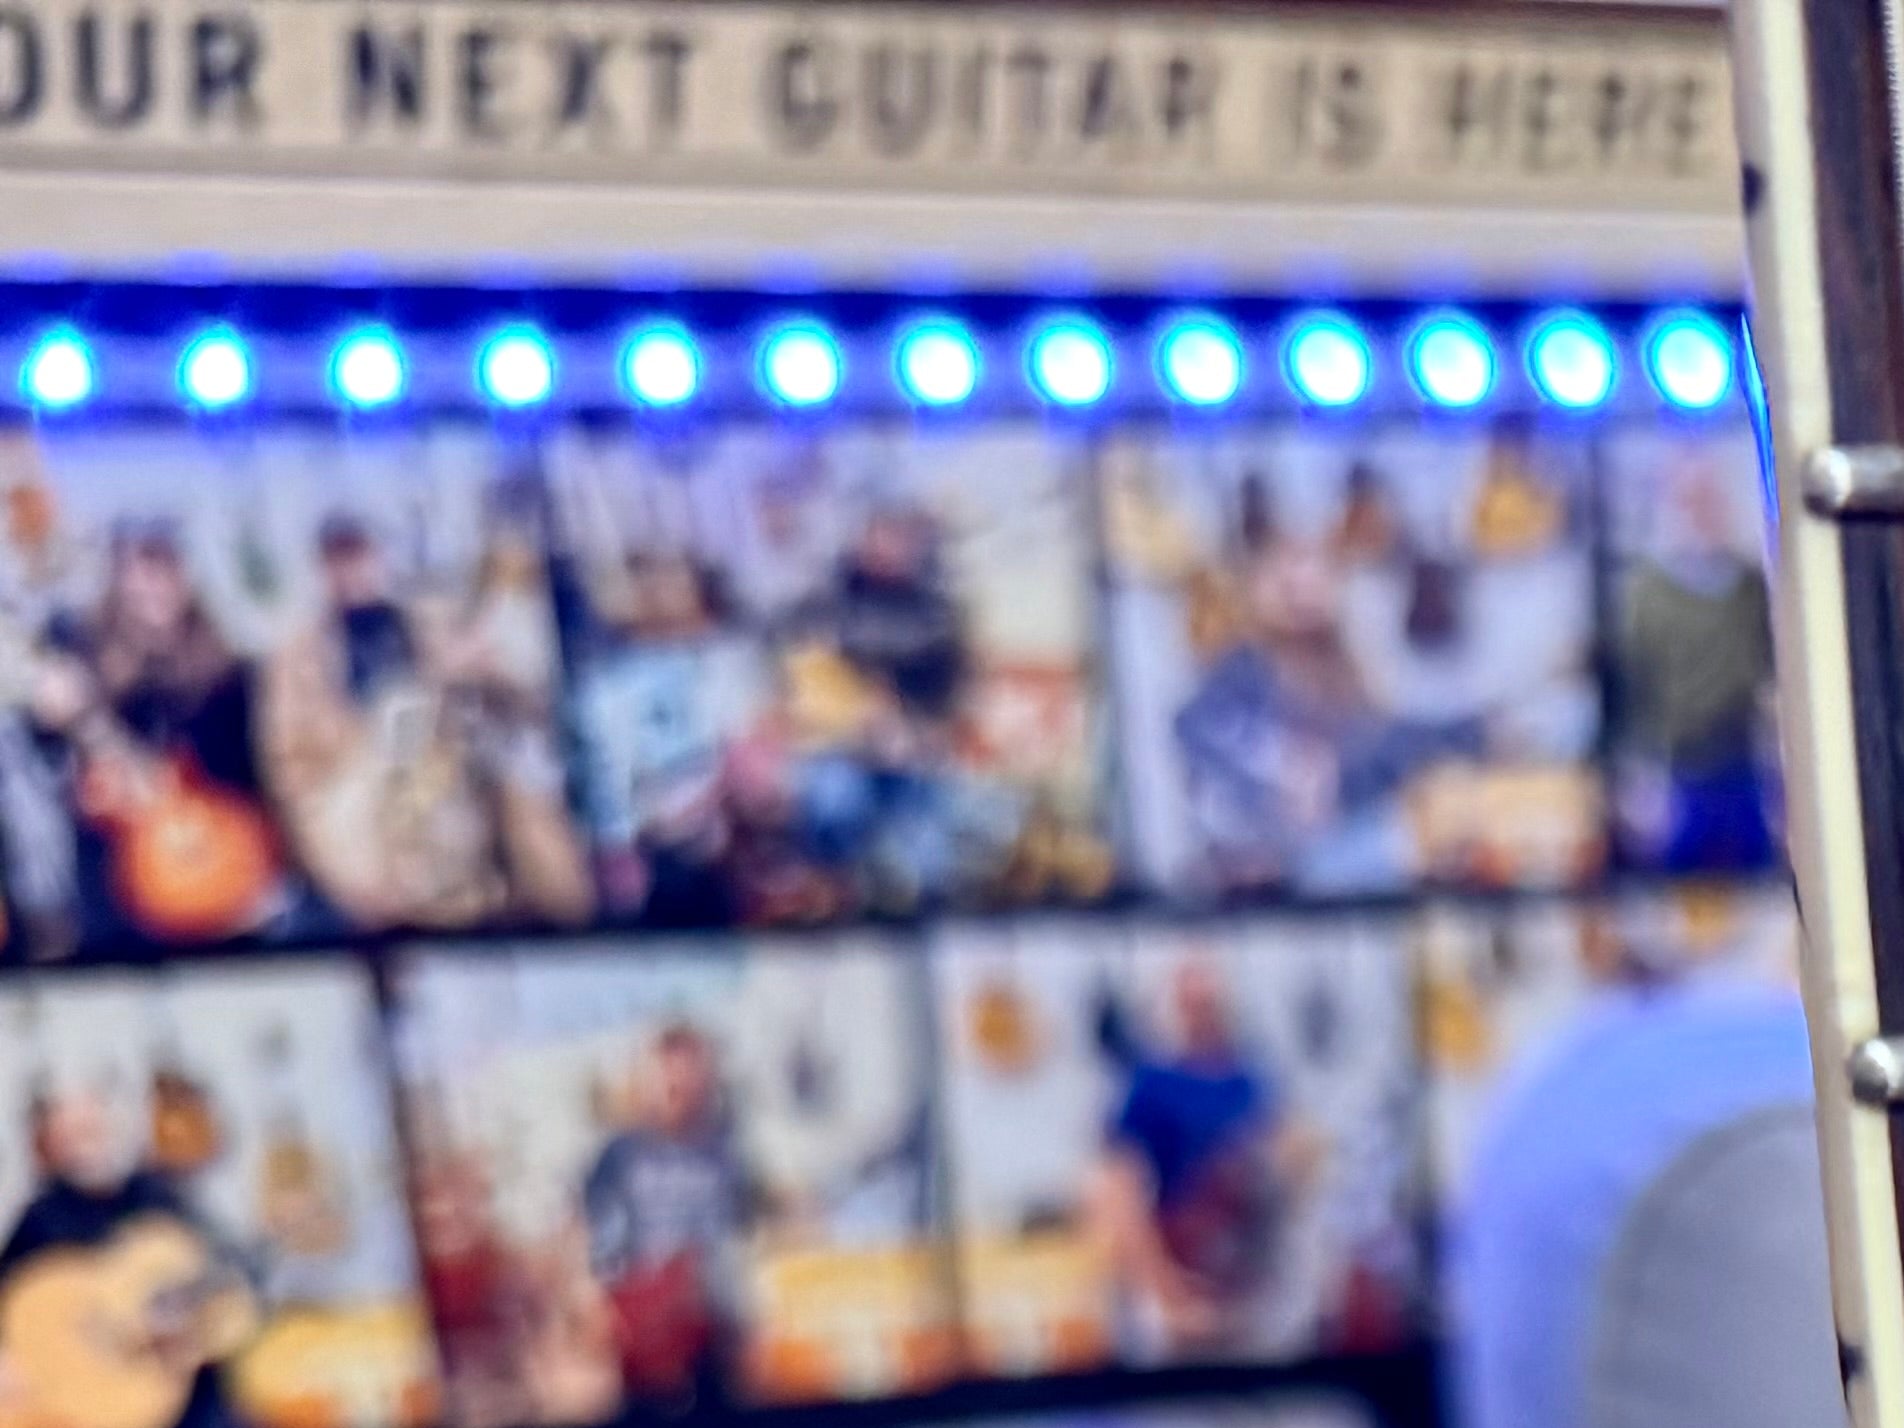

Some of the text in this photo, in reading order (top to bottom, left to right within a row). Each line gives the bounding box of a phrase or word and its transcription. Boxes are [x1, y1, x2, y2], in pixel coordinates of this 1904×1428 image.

[345, 22, 700, 150] NEXT
[770, 38, 1215, 168] GUITAR
[1290, 58, 1385, 168] IS
[1440, 62, 1712, 175] HERE
